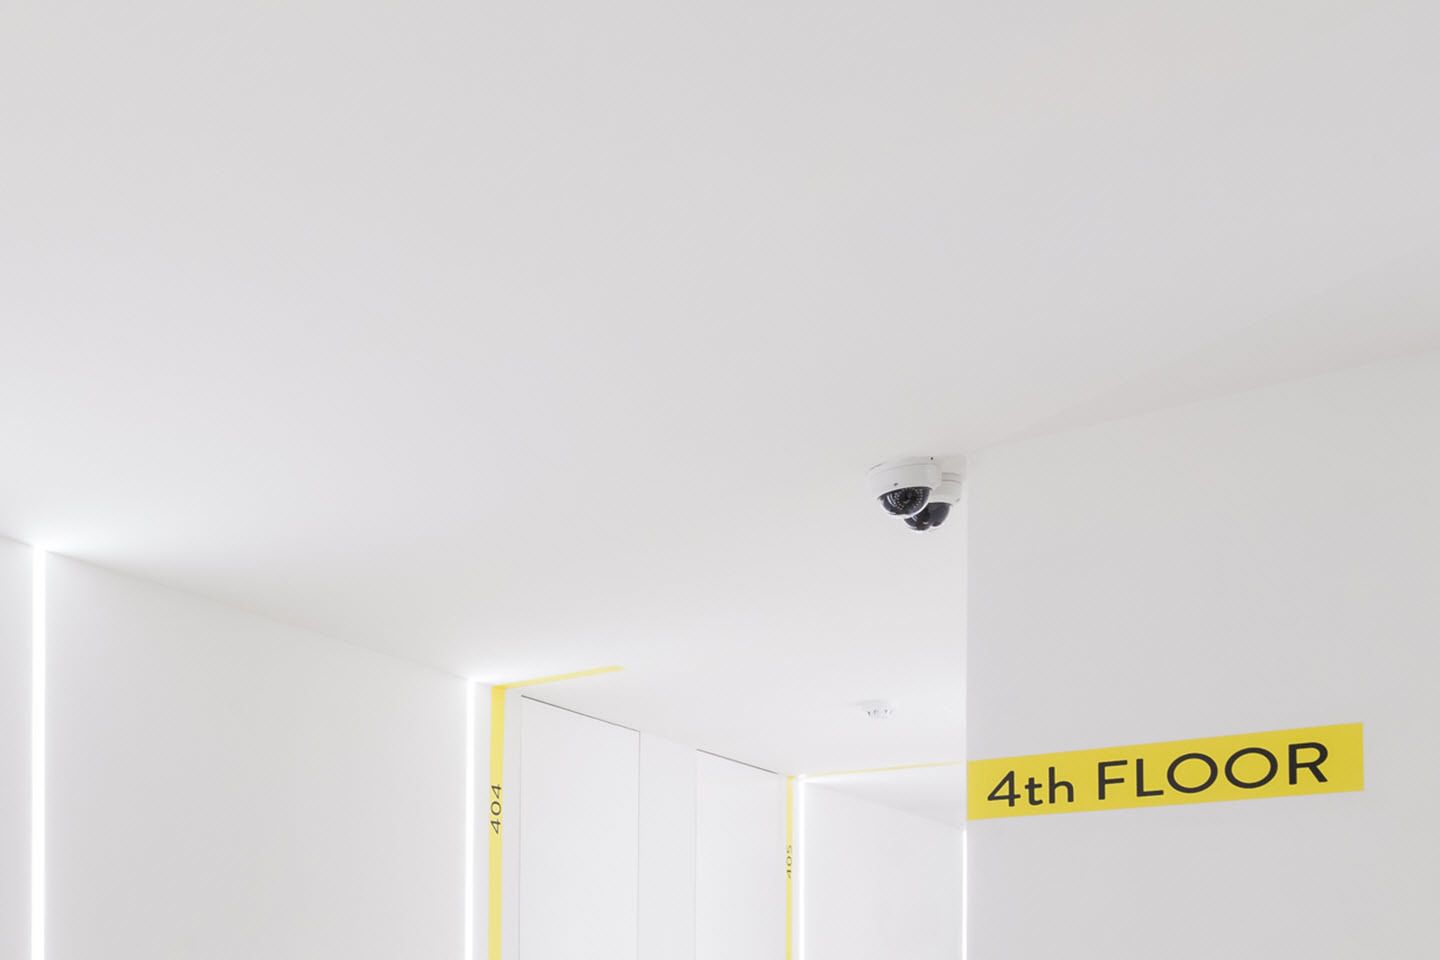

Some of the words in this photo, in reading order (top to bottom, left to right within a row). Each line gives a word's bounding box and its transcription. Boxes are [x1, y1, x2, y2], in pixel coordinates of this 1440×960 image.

[987, 766, 1075, 808] 4th
[1097, 741, 1329, 801] FLOOR
[490, 784, 502, 835] 404
